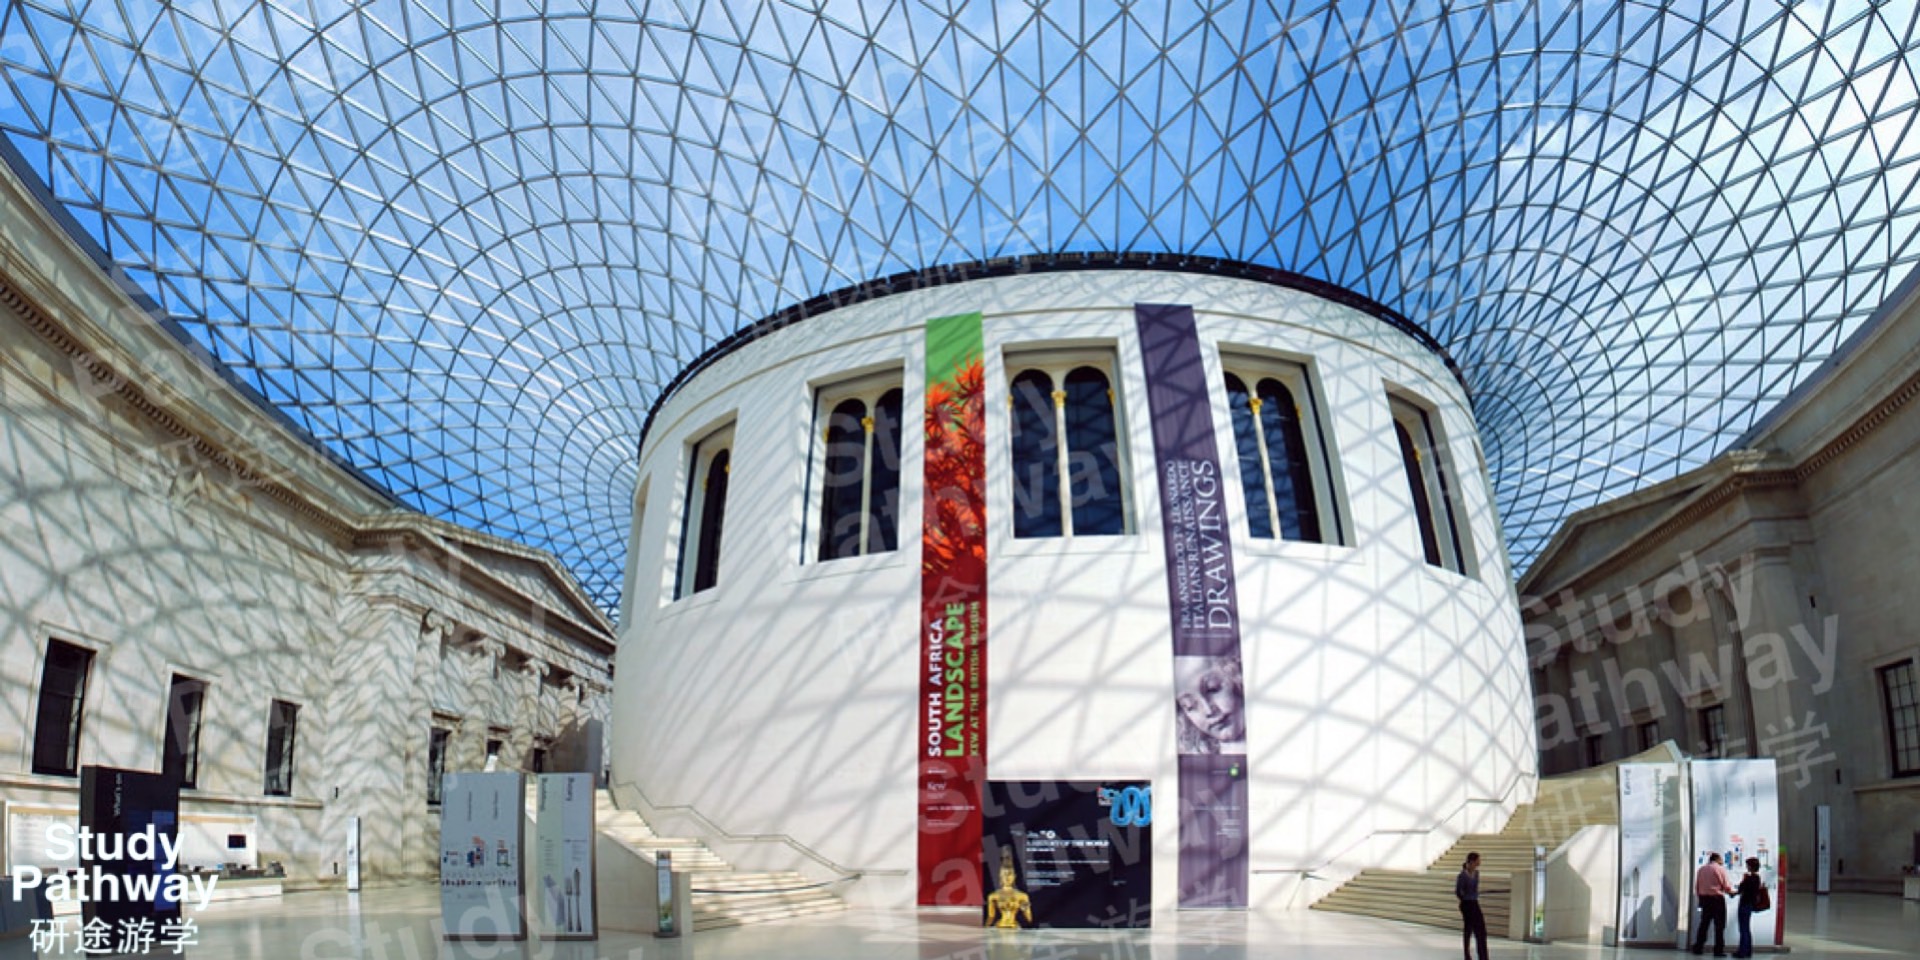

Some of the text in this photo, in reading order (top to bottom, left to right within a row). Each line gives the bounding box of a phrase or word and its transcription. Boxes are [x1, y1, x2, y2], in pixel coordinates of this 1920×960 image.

[1165, 460, 1183, 523] LEONARDO
[1177, 460, 1206, 629] ITALIAN RENAISSANCE
[1191, 459, 1233, 629] DRAWINGS
[928, 693, 943, 757] SOUTH
[929, 618, 943, 686] AFRICA
[944, 602, 965, 757] LANDSCAPE
[969, 600, 980, 757] KEW AT THE BRITISH MUSEUM
